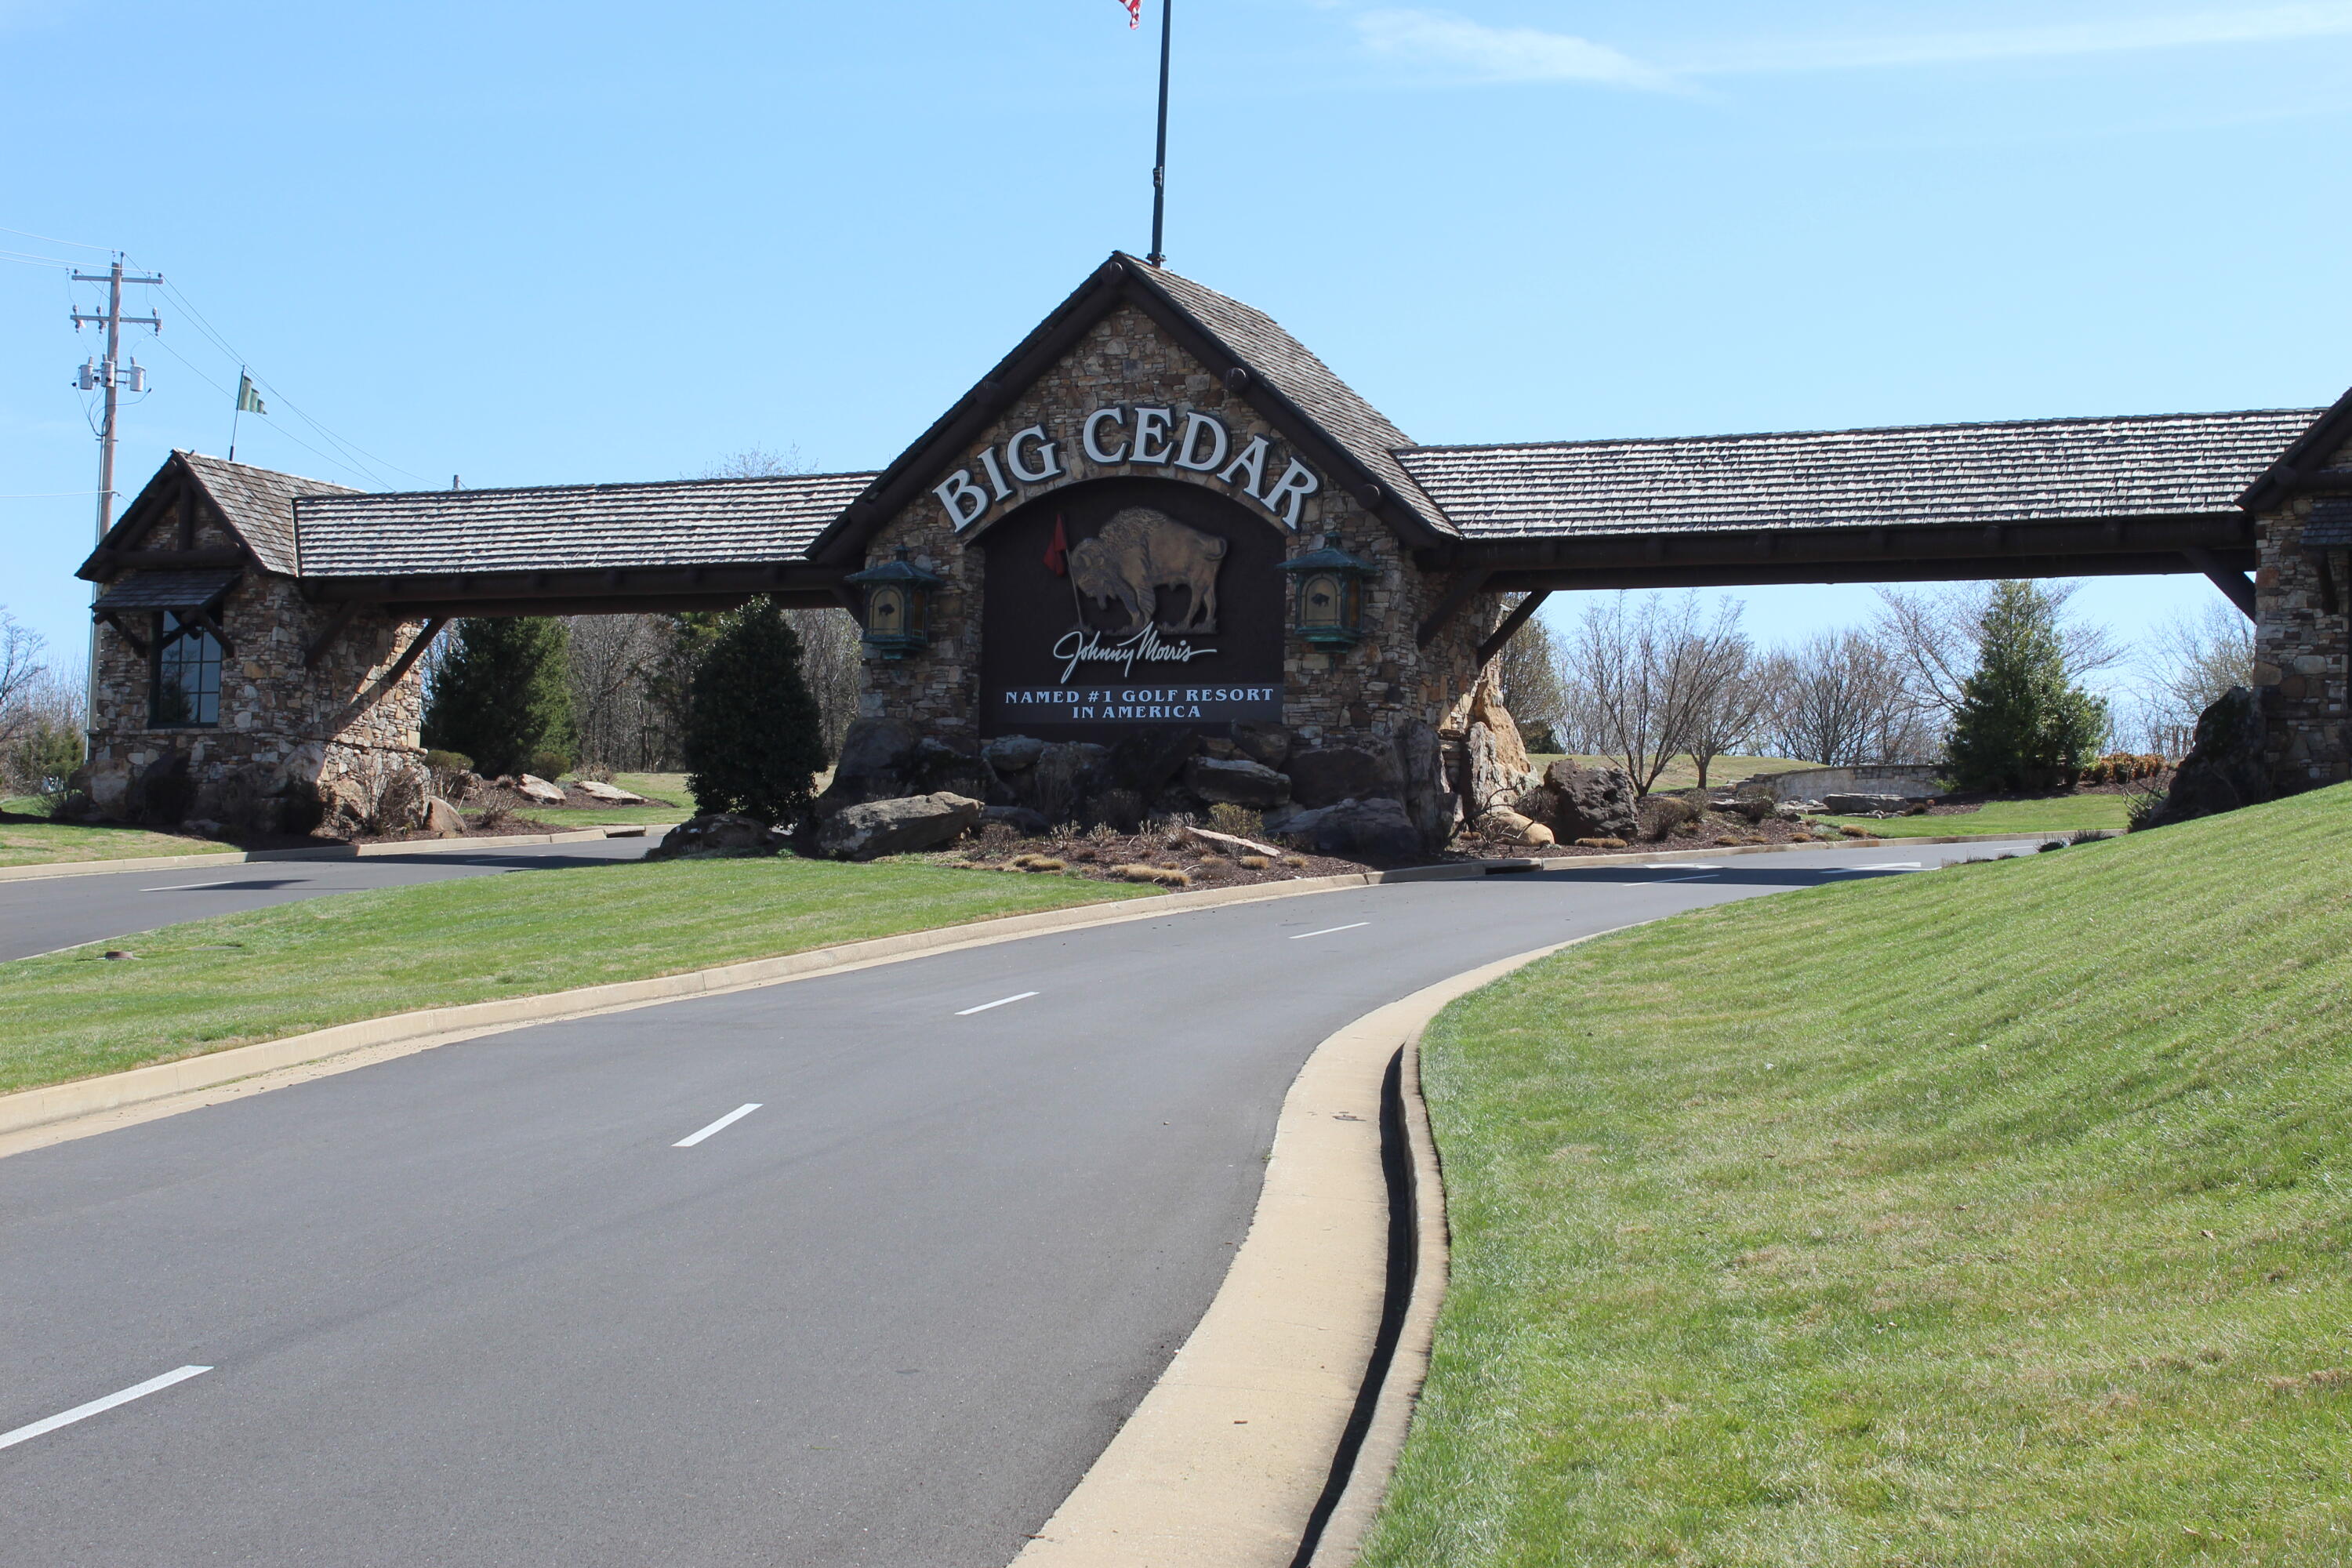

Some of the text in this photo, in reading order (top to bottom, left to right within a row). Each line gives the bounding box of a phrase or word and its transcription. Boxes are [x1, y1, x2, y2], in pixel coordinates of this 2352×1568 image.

[932, 407, 1320, 533] BIG CEDAR
[1053, 621, 1218, 684] Johnny Morris
[1005, 688, 1274, 703] NAMED #1 GOLF RESORT
[1072, 705, 1201, 719] IN AMERICA
